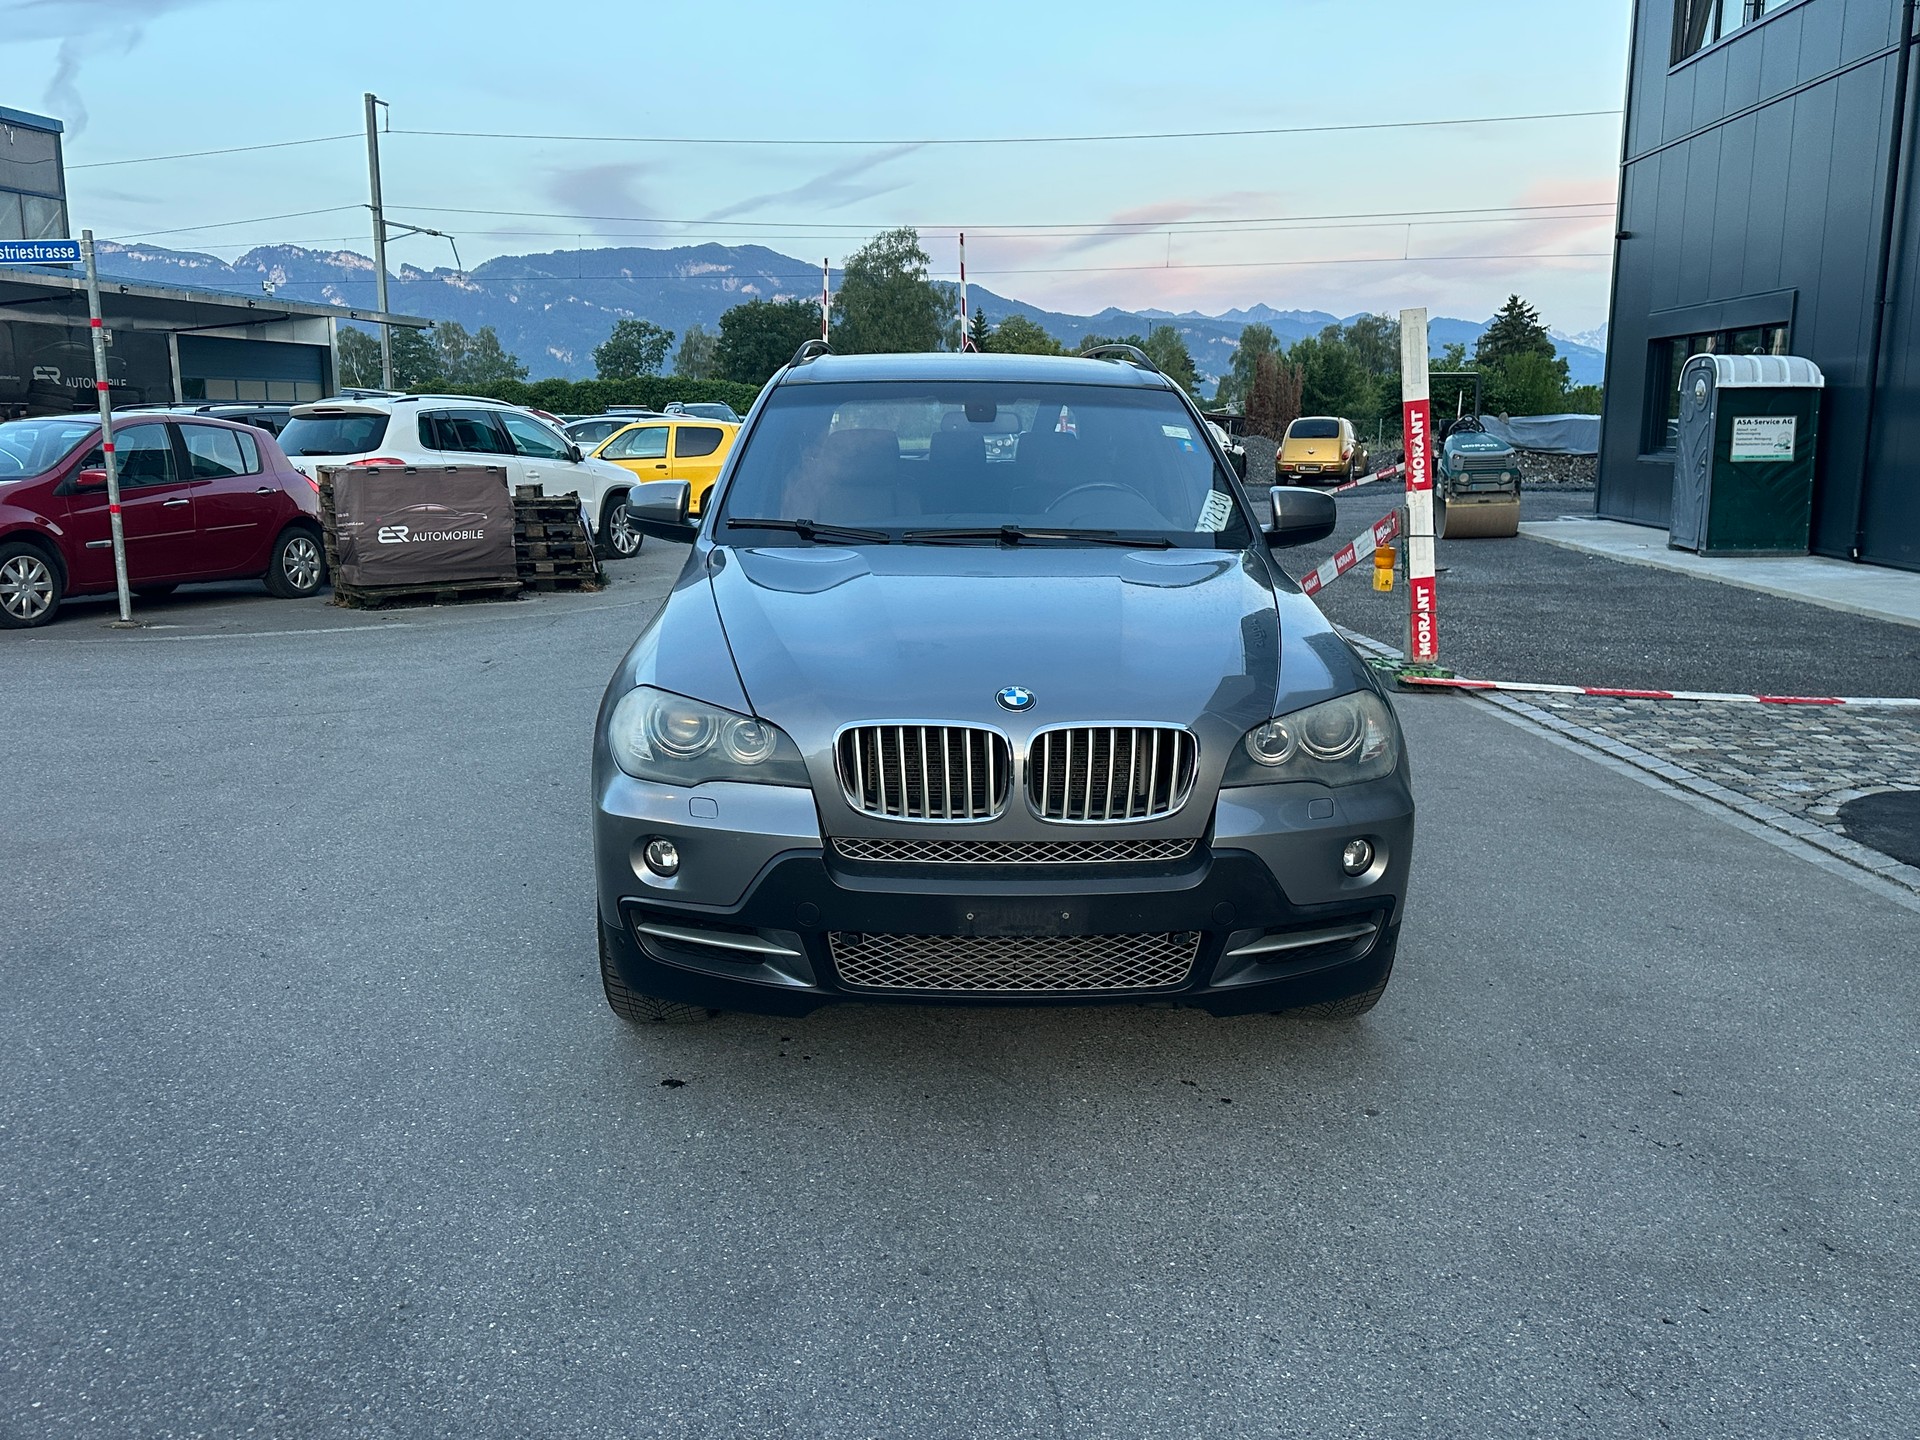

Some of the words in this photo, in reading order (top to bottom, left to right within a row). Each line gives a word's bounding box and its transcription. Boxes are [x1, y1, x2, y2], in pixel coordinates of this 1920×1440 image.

[1410, 410, 1426, 484] MORANT
[412, 529, 485, 542] AUTOMOBILE
[1416, 585, 1432, 656] MORANT
